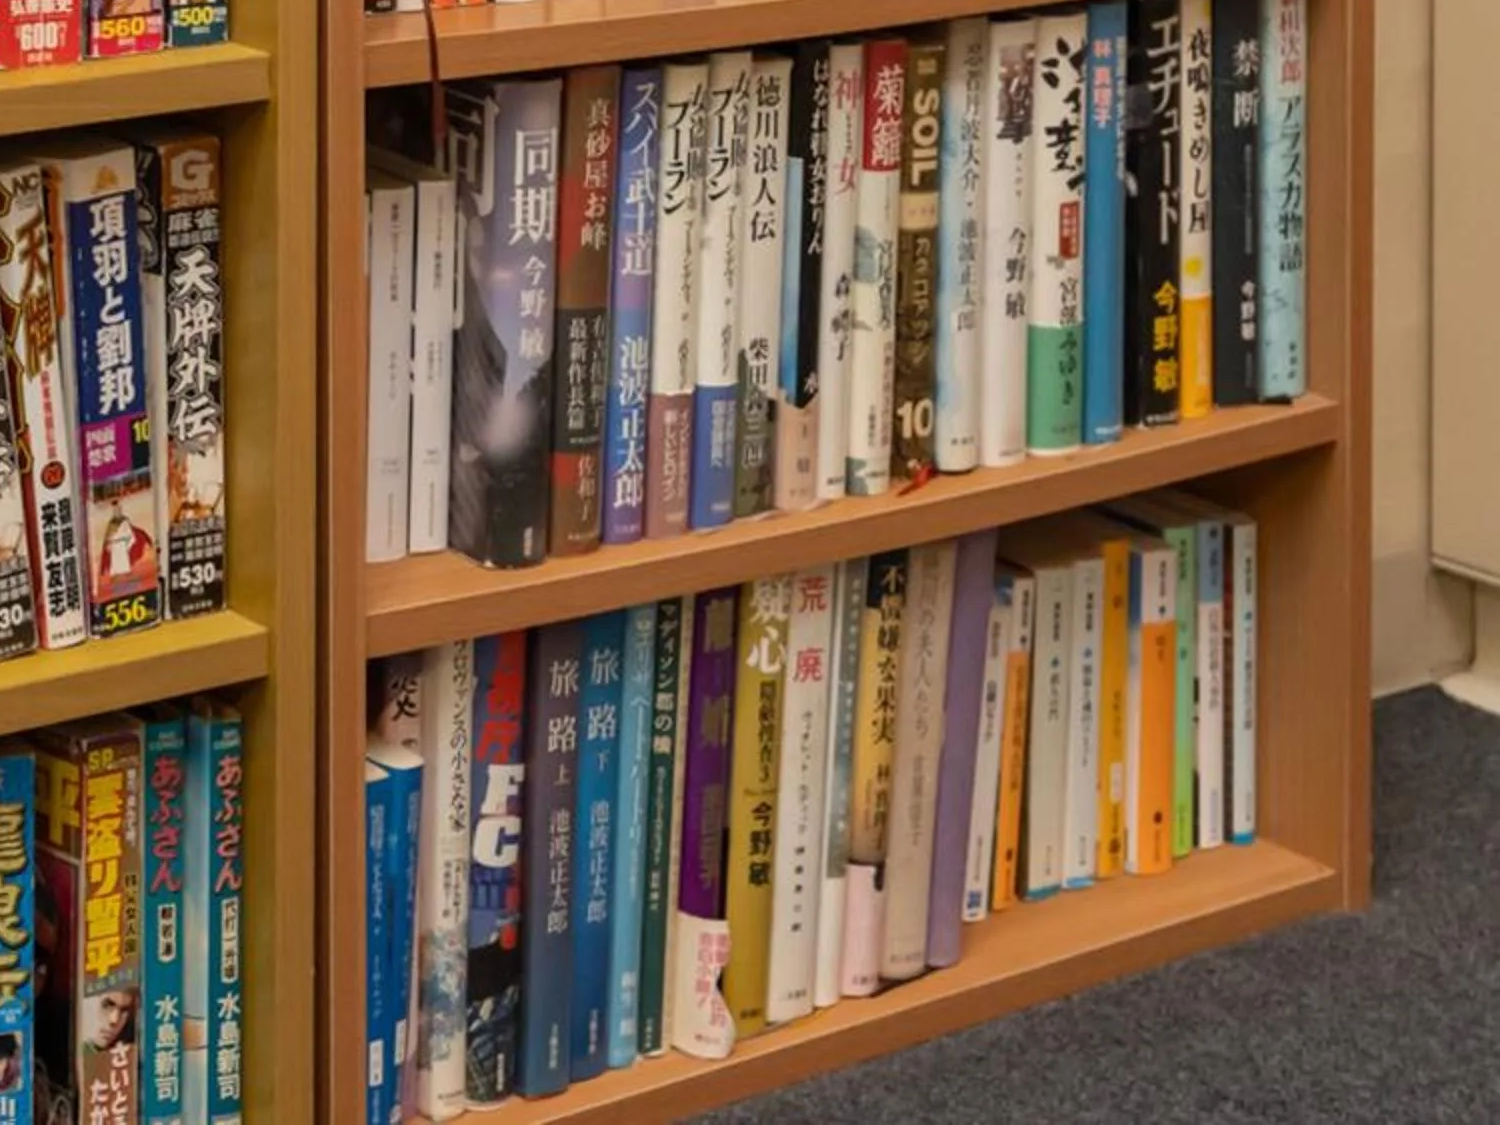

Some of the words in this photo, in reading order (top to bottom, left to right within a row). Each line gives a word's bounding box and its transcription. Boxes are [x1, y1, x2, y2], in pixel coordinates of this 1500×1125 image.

[20, 21, 58, 49] 600
[101, 16, 144, 37] 560
[179, 5, 214, 25] 500
[912, 88, 940, 186] SOIL
[1146, 17, 1181, 245] エチュード
[1232, 37, 1261, 129] 禁断
[508, 126, 559, 245] 同期
[619, 80, 659, 277] スパイ武士道
[749, 74, 782, 243] 徳川浪人伝
[1277, 95, 1304, 273] アラスカ物語
[87, 196, 138, 416] 項羽と劉邦
[168, 245, 221, 442] 天牌外伝
[517, 255, 548, 359] 今野敏
[1152, 279, 1179, 393] 今野敏
[613, 336, 651, 508] 池波正太郎
[897, 399, 934, 439] 10
[104, 597, 149, 633] 556
[178, 565, 216, 588] 530
[792, 575, 828, 684] 荒廃
[547, 659, 579, 754] 旅路
[587, 649, 620, 741] 旅路
[653, 599, 678, 755] マディソン郡の橋
[148, 756, 183, 893] あぶさん
[213, 754, 243, 891] あぶさん
[546, 810, 572, 935] 池波正太郎
[585, 800, 611, 925] 池波正太郎
[747, 800, 772, 888] 今野敏
[154, 993, 181, 1102] 水島新司
[216, 992, 242, 1101] 水島新司
